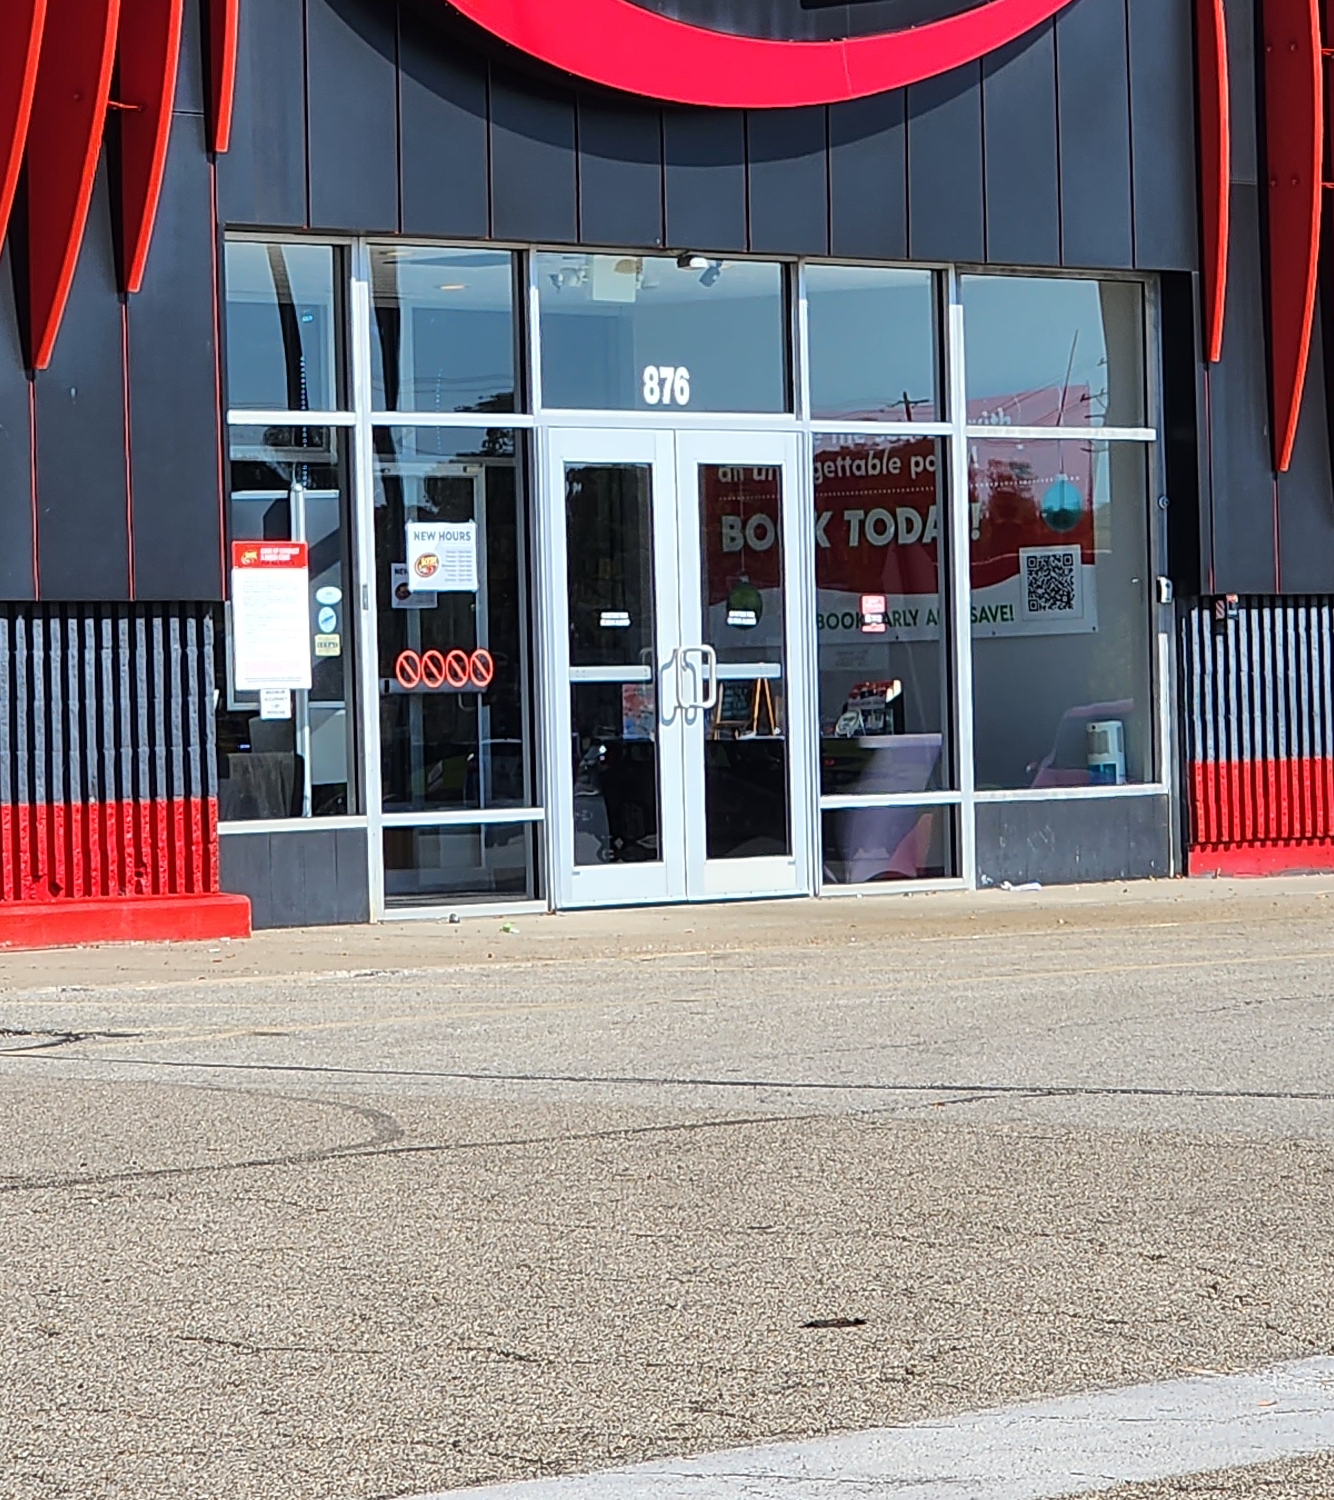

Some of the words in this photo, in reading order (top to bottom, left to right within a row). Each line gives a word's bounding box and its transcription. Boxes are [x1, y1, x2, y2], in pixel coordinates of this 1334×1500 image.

[643, 365, 690, 406] 876
[413, 530, 436, 541] NEW
[438, 530, 471, 541] HOURS
[721, 510, 833, 552] BOK
[879, 608, 919, 628] ARLY
[970, 604, 1014, 624] SAVE!
